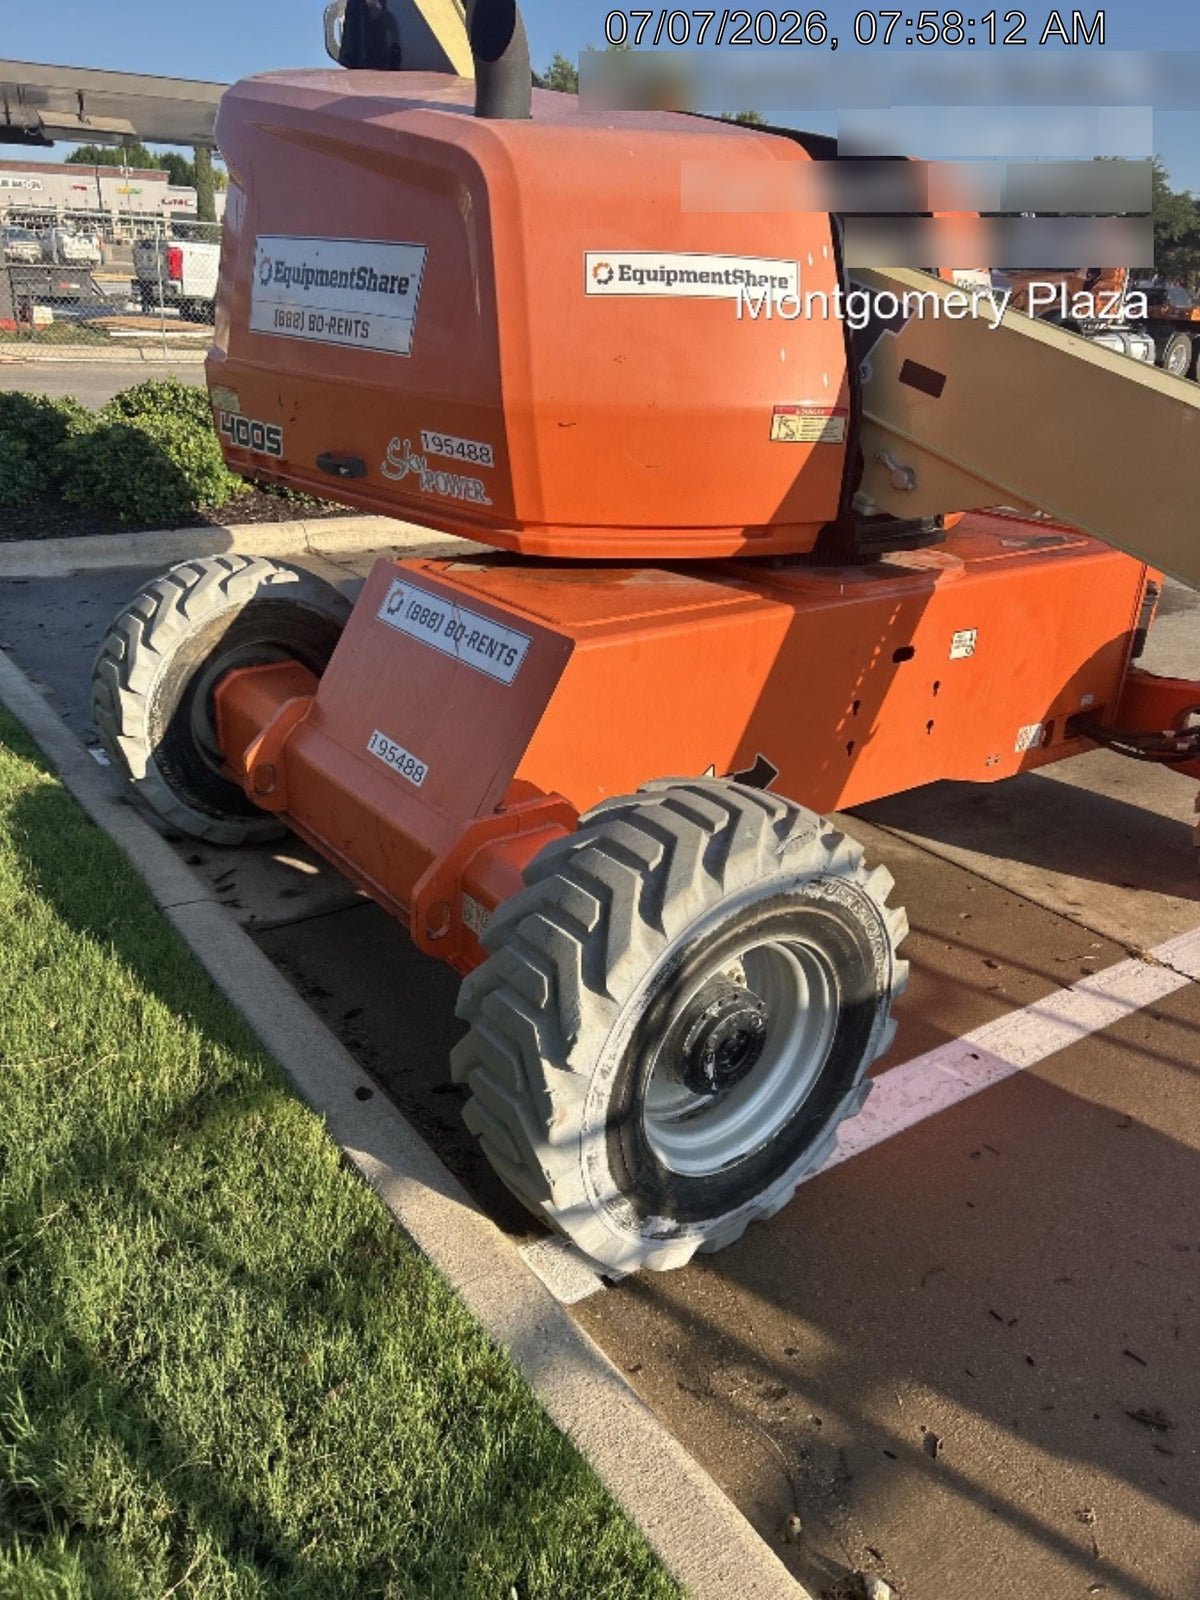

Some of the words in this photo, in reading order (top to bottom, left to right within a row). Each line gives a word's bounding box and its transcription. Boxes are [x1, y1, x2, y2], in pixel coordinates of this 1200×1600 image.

[273, 260, 410, 295] EquipmentShare
[617, 263, 789, 289] EquipmentShare
[274, 308, 305, 332] (888)
[308, 313, 371, 339] 80-RENTS
[220, 411, 283, 458] 400S
[422, 433, 491, 464] 195488
[380, 436, 428, 481] Sky
[421, 469, 493, 506] POWER
[404, 600, 446, 634] (888)
[443, 619, 519, 668] 80-RENTS
[368, 733, 426, 784] 195488
